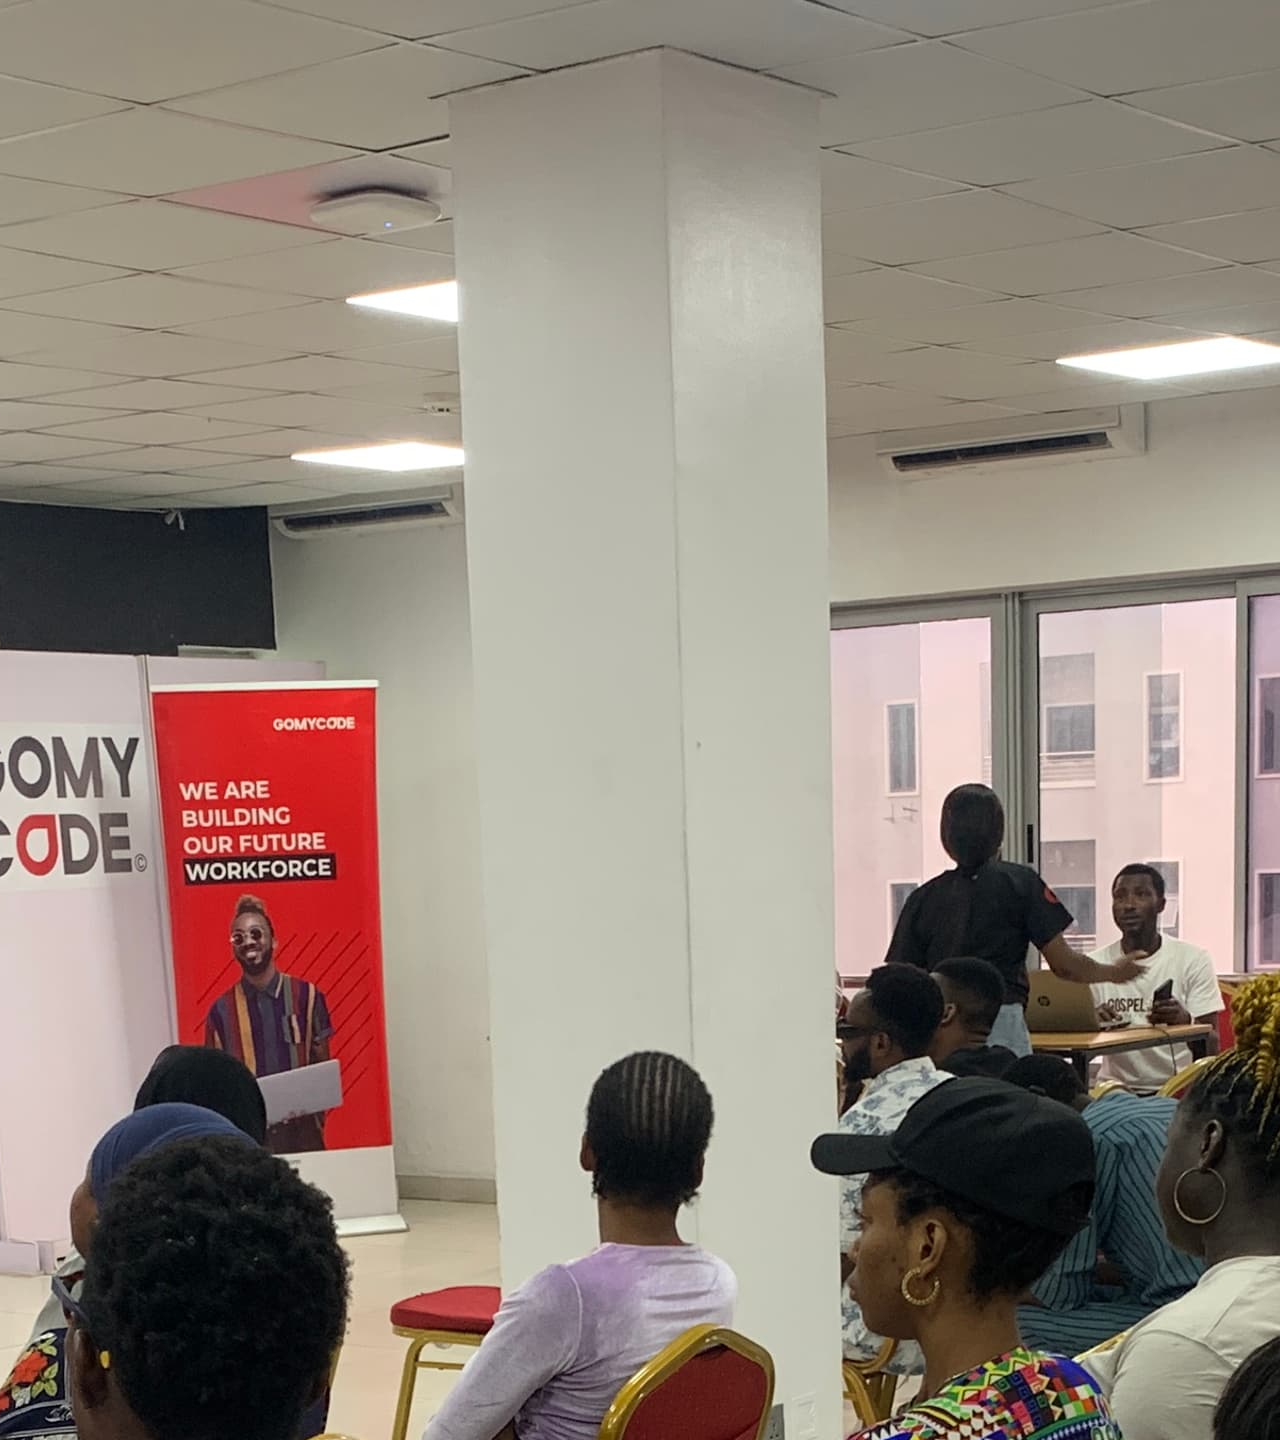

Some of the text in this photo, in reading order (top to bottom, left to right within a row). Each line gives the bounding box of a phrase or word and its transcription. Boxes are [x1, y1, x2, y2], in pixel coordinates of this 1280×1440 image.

[273, 717, 356, 731] GOMYCODE
[179, 780, 270, 800] WE ARE
[182, 807, 290, 827] BUILDING
[183, 832, 326, 854] OUR FUTURE
[185, 858, 331, 881] WORKFORCE
